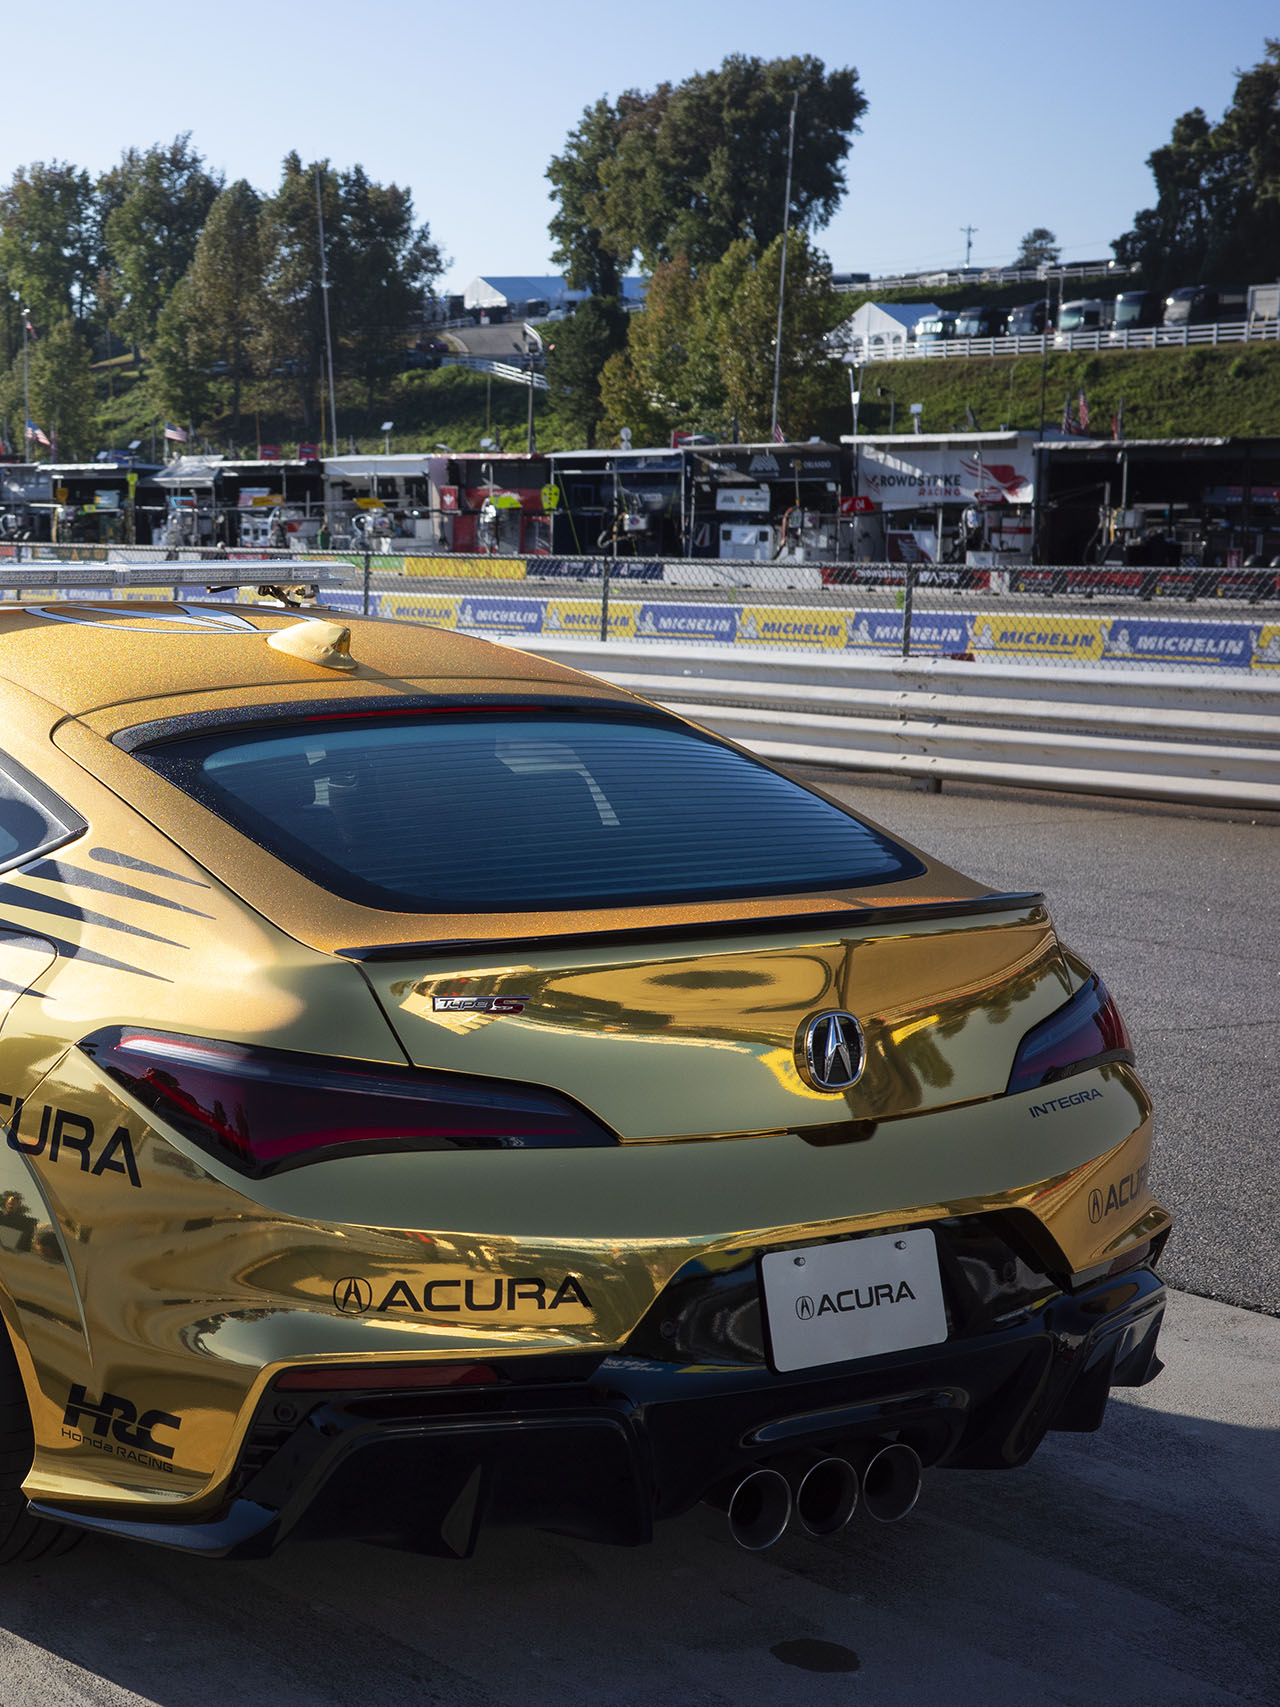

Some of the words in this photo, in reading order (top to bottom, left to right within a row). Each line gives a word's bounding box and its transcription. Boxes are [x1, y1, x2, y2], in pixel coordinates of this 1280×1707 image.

[918, 487, 961, 497] RACING
[395, 606, 452, 619] MICHELIN
[476, 609, 538, 624] MICHELIN
[563, 613, 630, 627] MICHLIN
[658, 617, 731, 632] MICHELIN
[761, 622, 840, 636] MICHELIN
[999, 630, 1095, 647] MICHELIN
[1136, 635, 1244, 655] MICHELIN
[1028, 1088, 1104, 1118] INTEGRA
[377, 1276, 593, 1312] ACURA
[817, 1280, 916, 1316] ACURA
[63, 1383, 182, 1459] HRC
[61, 1427, 113, 1453] Honda
[116, 1445, 174, 1473] RACING
